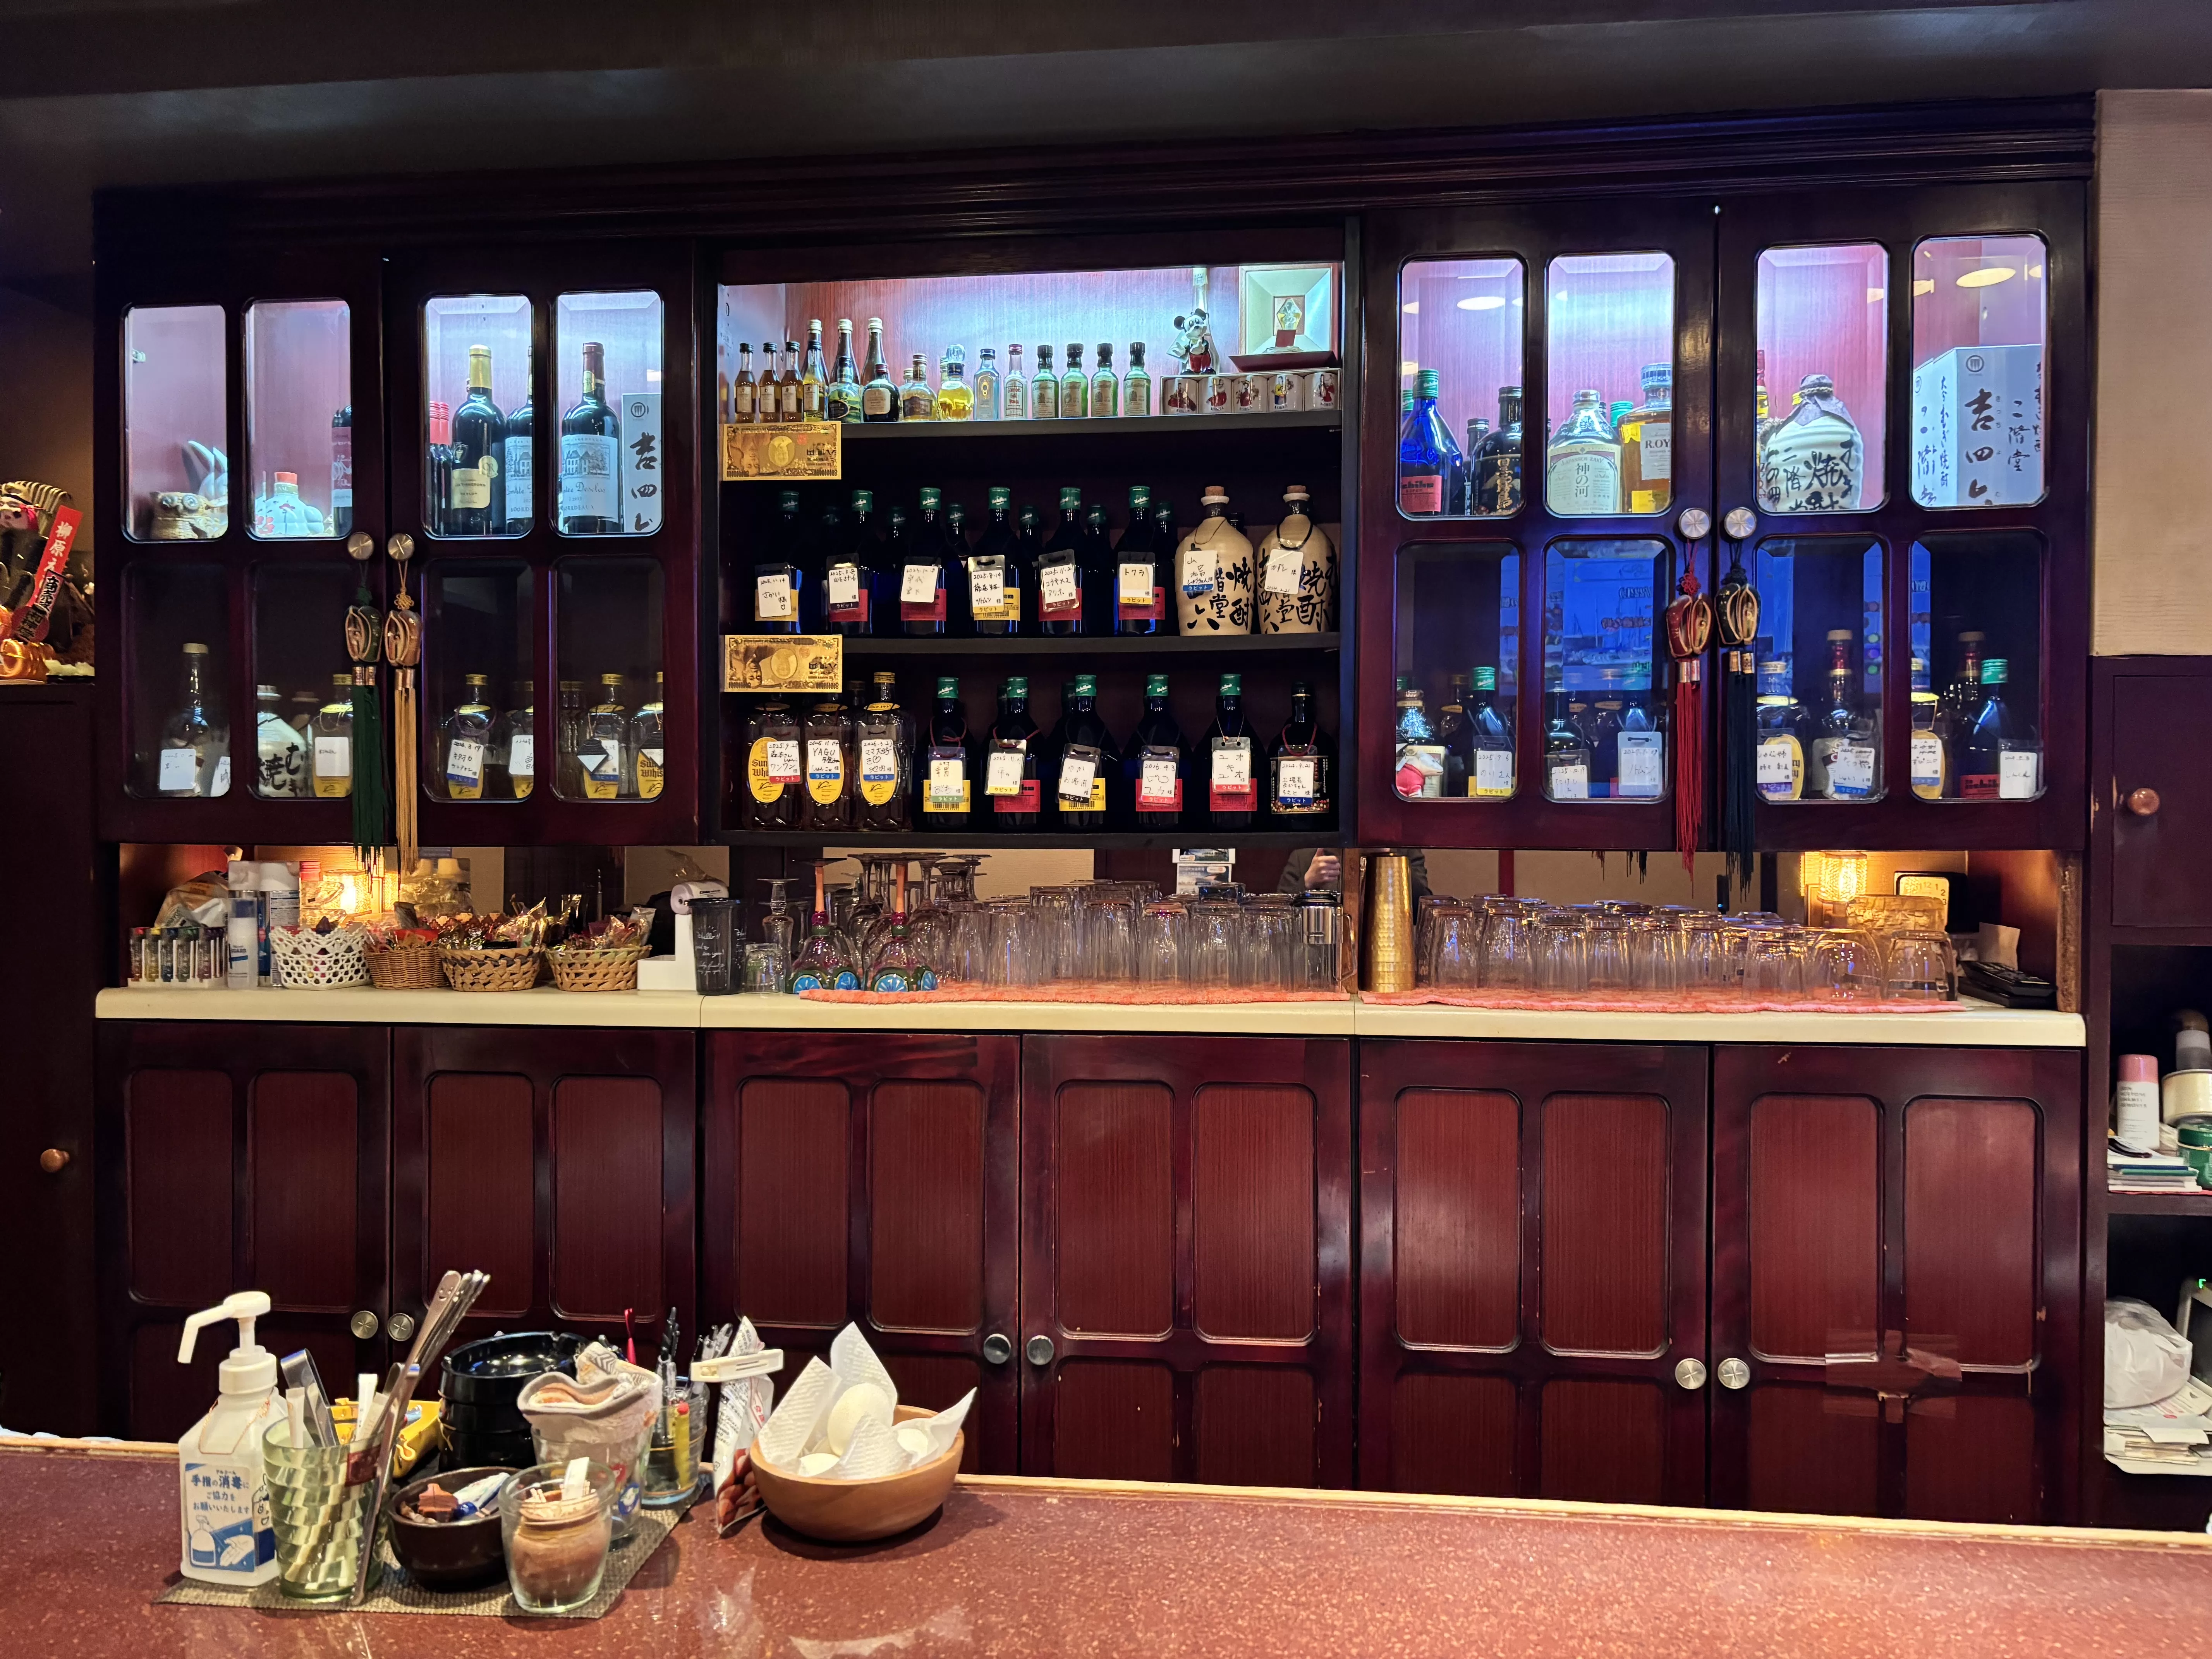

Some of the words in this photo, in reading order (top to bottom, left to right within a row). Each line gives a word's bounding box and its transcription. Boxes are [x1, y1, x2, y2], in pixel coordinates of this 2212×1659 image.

[2008, 400, 2030, 471] 二階堂
[1645, 438, 1671, 449] ROY
[1401, 480, 1434, 489] chiko
[1495, 458, 1513, 509] 黒霧島
[1575, 463, 1590, 498] 神の河
[1225, 556, 1254, 631] 焼酎
[1297, 560, 1328, 632] 焼酎
[813, 747, 835, 757] YAGU
[751, 759, 768, 768] Sun
[752, 768, 768, 778] Whi
[191, 1474, 249, 1489] 手指の消毒に
[207, 1491, 235, 1501] ご協力を
[193, 1501, 249, 1514] お願いいたします
